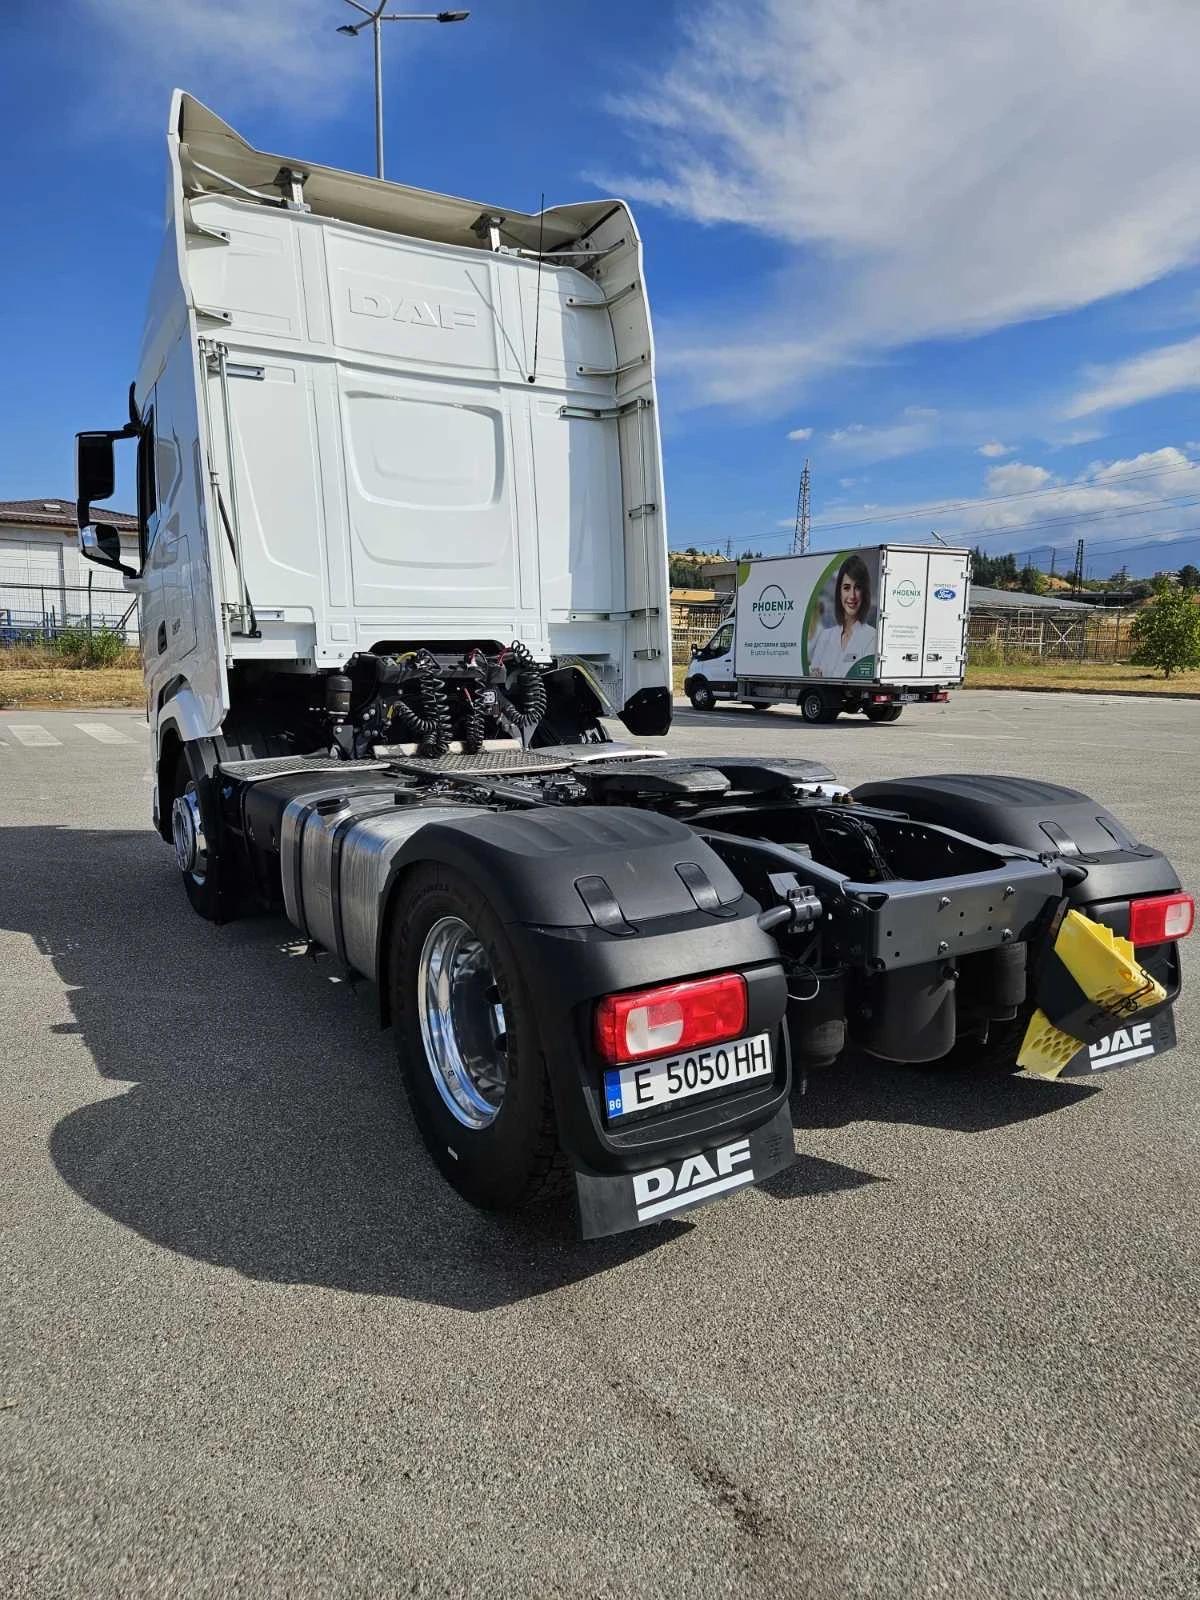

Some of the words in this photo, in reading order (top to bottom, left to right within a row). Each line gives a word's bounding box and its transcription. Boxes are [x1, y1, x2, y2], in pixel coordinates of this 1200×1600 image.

[348, 287, 477, 330] DAF
[752, 600, 794, 612] PHOENIX
[892, 589, 921, 597] PHOENIX
[1088, 1022, 1152, 1058] DAF
[634, 1068, 654, 1105] E
[666, 1050, 729, 1094] 5050
[734, 1039, 767, 1077] HH
[609, 1098, 622, 1111] BG
[632, 1138, 751, 1206] DAF
